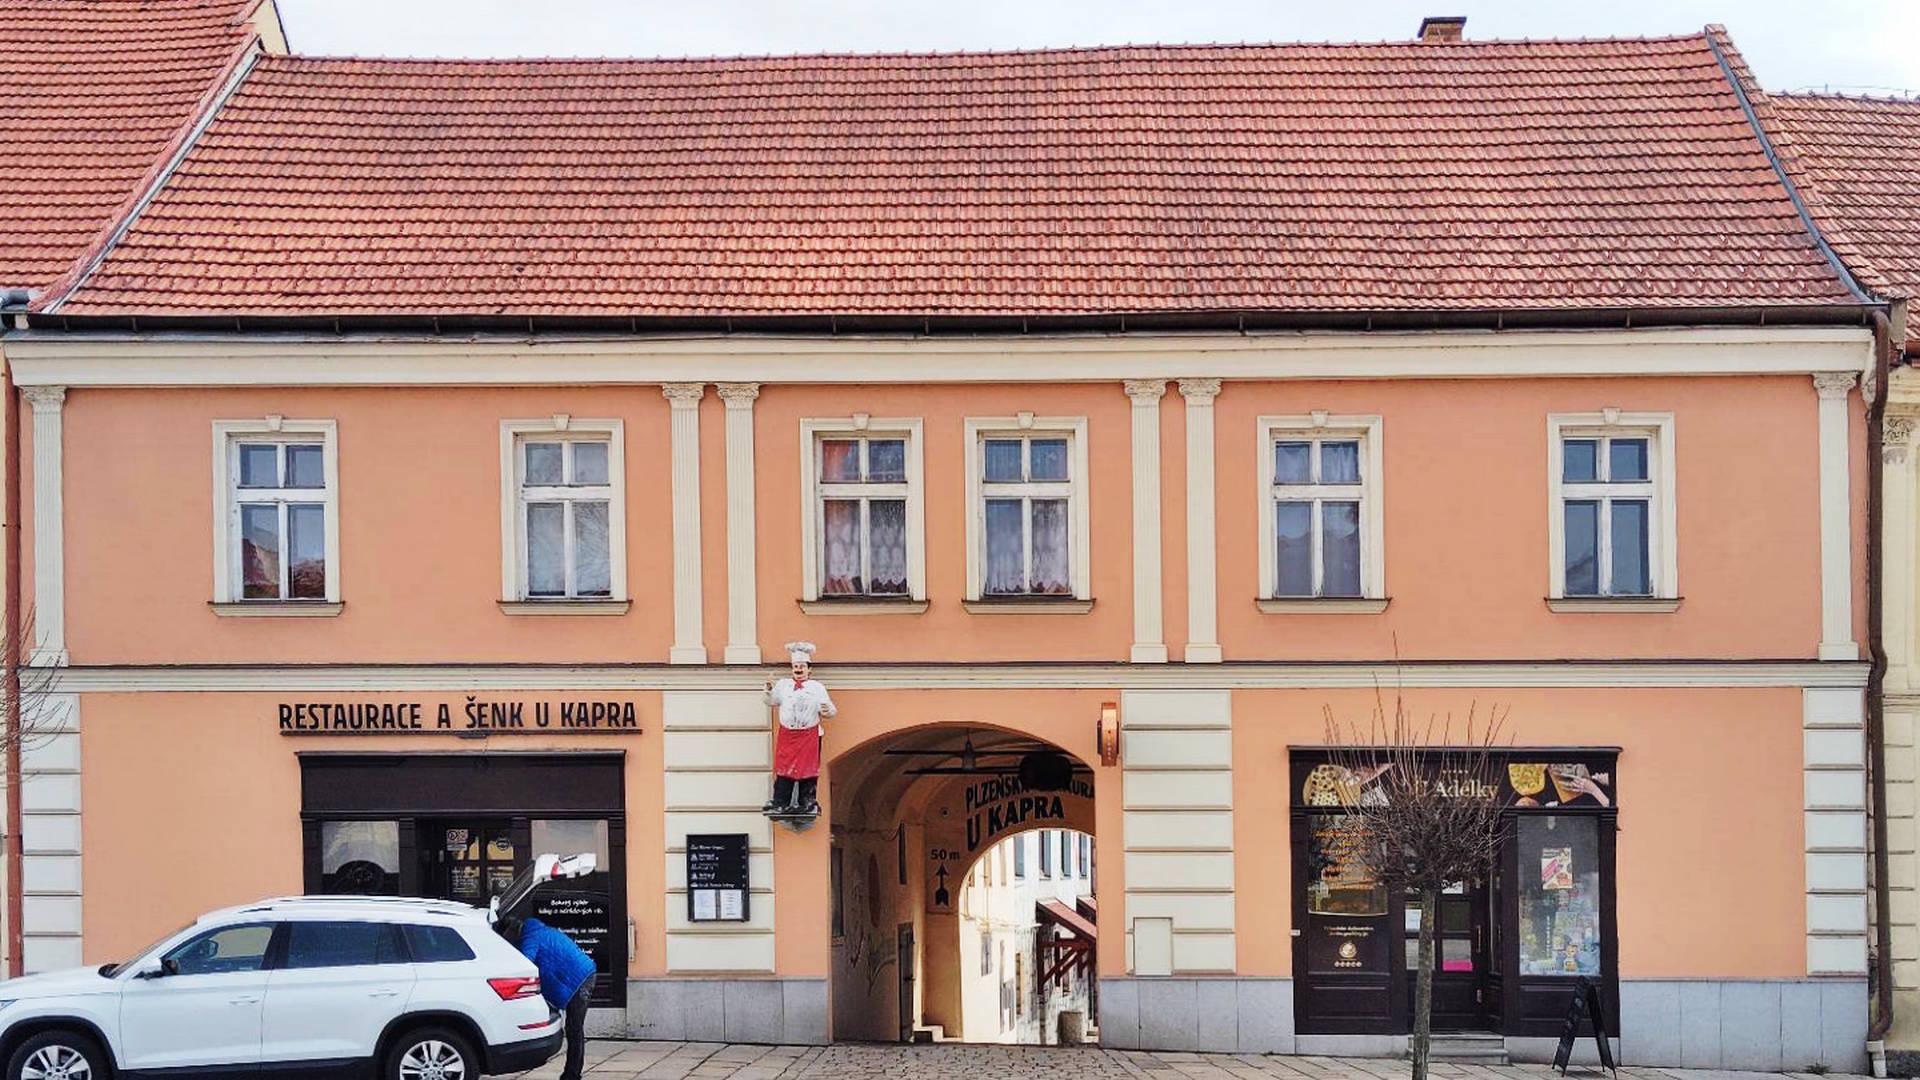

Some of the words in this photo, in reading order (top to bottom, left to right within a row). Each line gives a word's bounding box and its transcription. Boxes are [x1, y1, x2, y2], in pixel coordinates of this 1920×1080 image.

[278, 703, 422, 729] RESTAURACE
[437, 703, 452, 729] A
[465, 695, 524, 728] ŠENK
[535, 702, 549, 728] U
[560, 702, 637, 728] KAPRA
[966, 813, 981, 851] U
[988, 795, 1065, 838] KAPRA
[930, 849, 947, 860] 50
[950, 851, 960, 860] m
